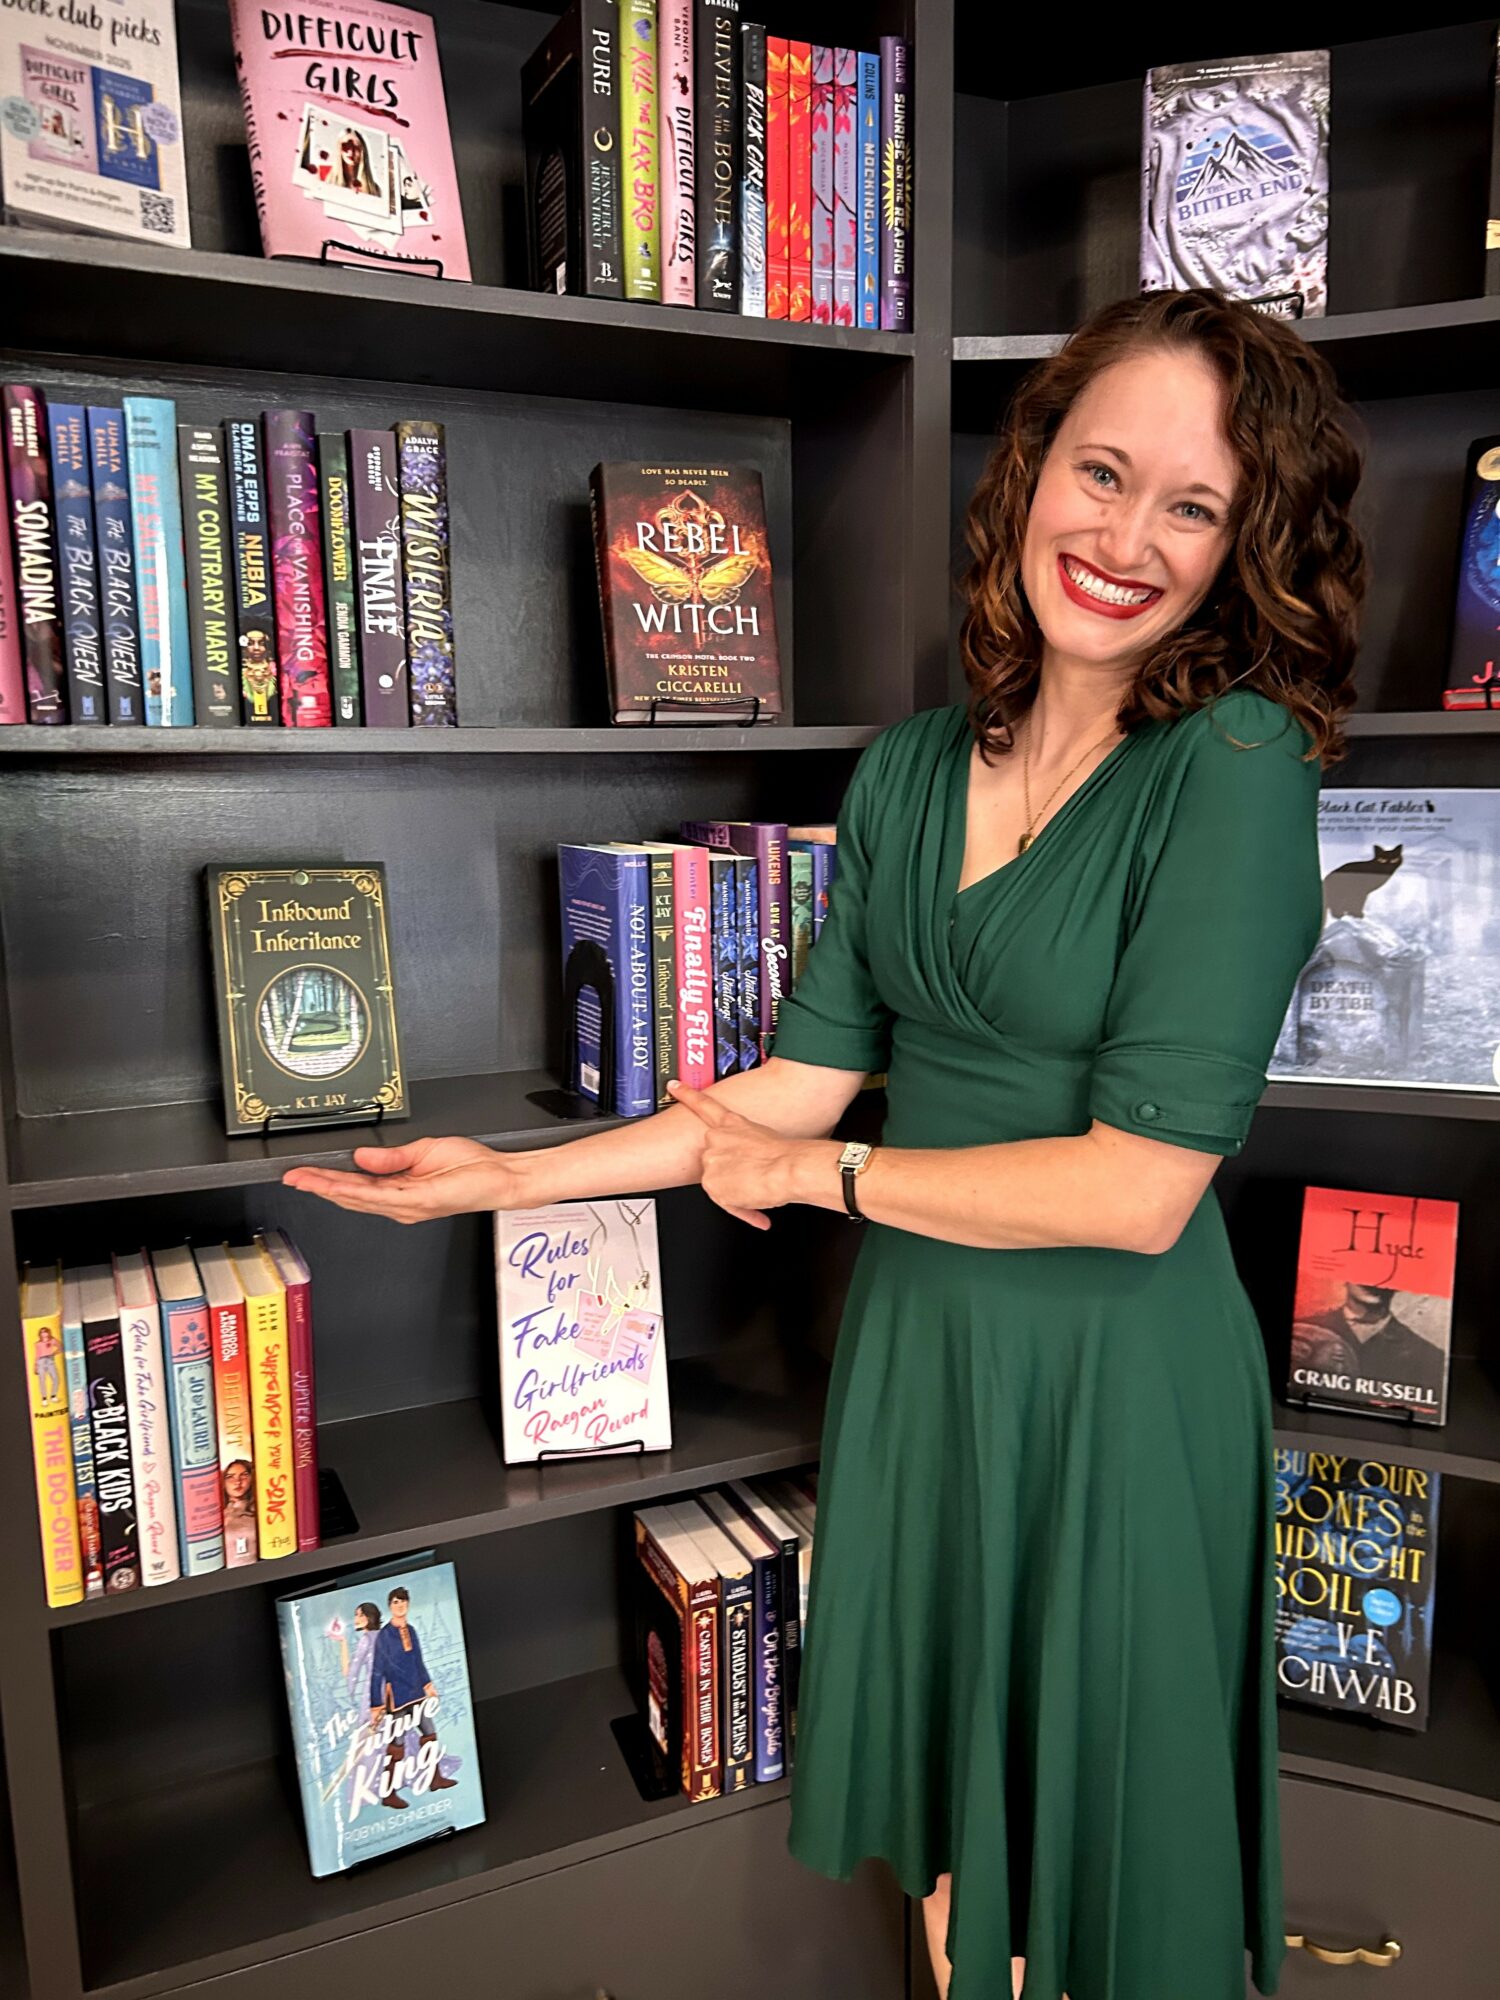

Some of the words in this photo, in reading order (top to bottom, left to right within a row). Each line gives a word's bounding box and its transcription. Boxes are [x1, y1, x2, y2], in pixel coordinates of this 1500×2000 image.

[60, 0, 104, 31] club
[110, 17, 162, 47] picks
[261, 9, 424, 61] DIFFICULT
[682, 6, 690, 63] VERONICA
[305, 62, 400, 109] GIRLS
[592, 28, 612, 96] PURE
[630, 46, 655, 95] KILL
[715, 16, 732, 109] SILVER
[864, 62, 876, 100] COLLINS
[895, 46, 906, 84] COLLINS
[42, 82, 78, 105] GIRLS
[745, 82, 765, 144] BLACK
[894, 93, 905, 160] SUNRISE
[630, 128, 656, 174] LAX
[676, 106, 695, 200] DIFFICULT
[745, 144, 765, 191] GIRL
[896, 164, 905, 179] ON
[631, 177, 657, 232] BRO
[715, 141, 732, 225] BONE
[864, 142, 876, 255] MOCKINGJAY
[896, 182, 905, 203] THE
[1178, 186, 1253, 221] BITTER
[1259, 174, 1303, 199] END
[679, 209, 695, 265] GIRLS
[746, 192, 765, 272] UNLIMITED
[894, 206, 905, 275] REAPING
[10, 408, 25, 447] EMEZI
[56, 425, 69, 464] EMILL
[68, 417, 82, 470] JUMATA
[95, 428, 108, 467] EMILL
[107, 421, 120, 473] JUMATA
[232, 424, 243, 472] CLARENCE
[240, 424, 257, 475] OMAR
[136, 473, 160, 507] MY
[195, 473, 218, 505] MY
[641, 468, 662, 476] LOVE
[683, 469, 708, 477] NEVER
[710, 469, 729, 477] BEEN
[235, 485, 246, 522] HAYNES
[244, 479, 260, 523] EPPS
[286, 474, 306, 535] PLACE
[138, 513, 161, 575] SALTY
[238, 532, 246, 549] THE
[294, 538, 303, 555] FOR
[328, 477, 346, 581] DOOMFLOWER
[636, 521, 751, 556] REBEL
[14, 499, 57, 624] SOMADINA
[64, 543, 96, 616] BLACK
[102, 544, 134, 617] BLACK
[197, 509, 225, 616] CONTRARY
[245, 535, 267, 606] NUBIA
[403, 491, 443, 648] WISTERIA
[292, 556, 313, 661] VANISHING
[360, 537, 398, 637] FINALE
[143, 585, 161, 641] MARY
[632, 602, 760, 636] WITCH
[67, 621, 103, 687] QUEEN
[105, 622, 140, 688] QUEEN
[204, 621, 229, 676] MARY
[337, 631, 352, 669] GAMMON
[668, 664, 729, 678] KRISTEN
[656, 681, 742, 695] CICCARELLI
[1354, 800, 1377, 813] Cat
[767, 840, 781, 885] LUKENS
[256, 896, 356, 923] Inkbound
[629, 904, 646, 944] NOT
[654, 907, 672, 918] JAY
[769, 901, 780, 924] LOVE
[250, 928, 362, 954] Inheritance
[769, 928, 780, 939] AT
[630, 947, 648, 1012] ABOUT
[680, 906, 709, 1013] Finally
[761, 937, 788, 1001] Second
[657, 957, 674, 1011] Inkbound
[1310, 996, 1331, 1010] BY
[631, 1015, 648, 1029] A
[658, 1013, 674, 1075] Inheritance
[686, 1009, 710, 1066] Fitz
[632, 1035, 649, 1070] BOY
[324, 1094, 348, 1106] JAY
[508, 1231, 590, 1279] Rules
[1332, 1197, 1425, 1287] Hyde
[547, 1269, 581, 1303] for
[219, 1311, 231, 1362] SANDERSON
[228, 1314, 240, 1357] BRANDON
[269, 1303, 278, 1332] ADAM
[511, 1305, 582, 1359] Fake
[96, 1382, 117, 1407] The
[293, 1370, 311, 1424] JUPITER
[513, 1343, 649, 1412] Girlfriends
[1292, 1368, 1352, 1391] CRAIG
[1355, 1378, 1439, 1405] RUSSELL
[223, 1372, 242, 1447] DEFIANT
[523, 1398, 607, 1444] Raegan
[44, 1425, 68, 1468] THE
[73, 1423, 93, 1457] FIRST
[92, 1405, 130, 1464] BLACK
[295, 1428, 313, 1469] RISING
[76, 1459, 95, 1487] TEST
[97, 1467, 133, 1513] KIDS
[1273, 1447, 1349, 1483] BURY
[1358, 1461, 1429, 1500] OUR
[47, 1472, 75, 1573] DO-OVER
[1275, 1479, 1402, 1538] BONES
[732, 1629, 747, 1697] STARDUST
[1336, 1621, 1359, 1661] V.
[1365, 1628, 1392, 1669] E.
[700, 1680, 711, 1691] IN
[700, 1693, 712, 1724] THEIR
[322, 1709, 359, 1750] The
[346, 1696, 440, 1769] Future
[701, 1727, 713, 1764] BONES
[732, 1714, 747, 1756] VEINS
[764, 1726, 782, 1756] Side
[348, 1740, 447, 1824] King
